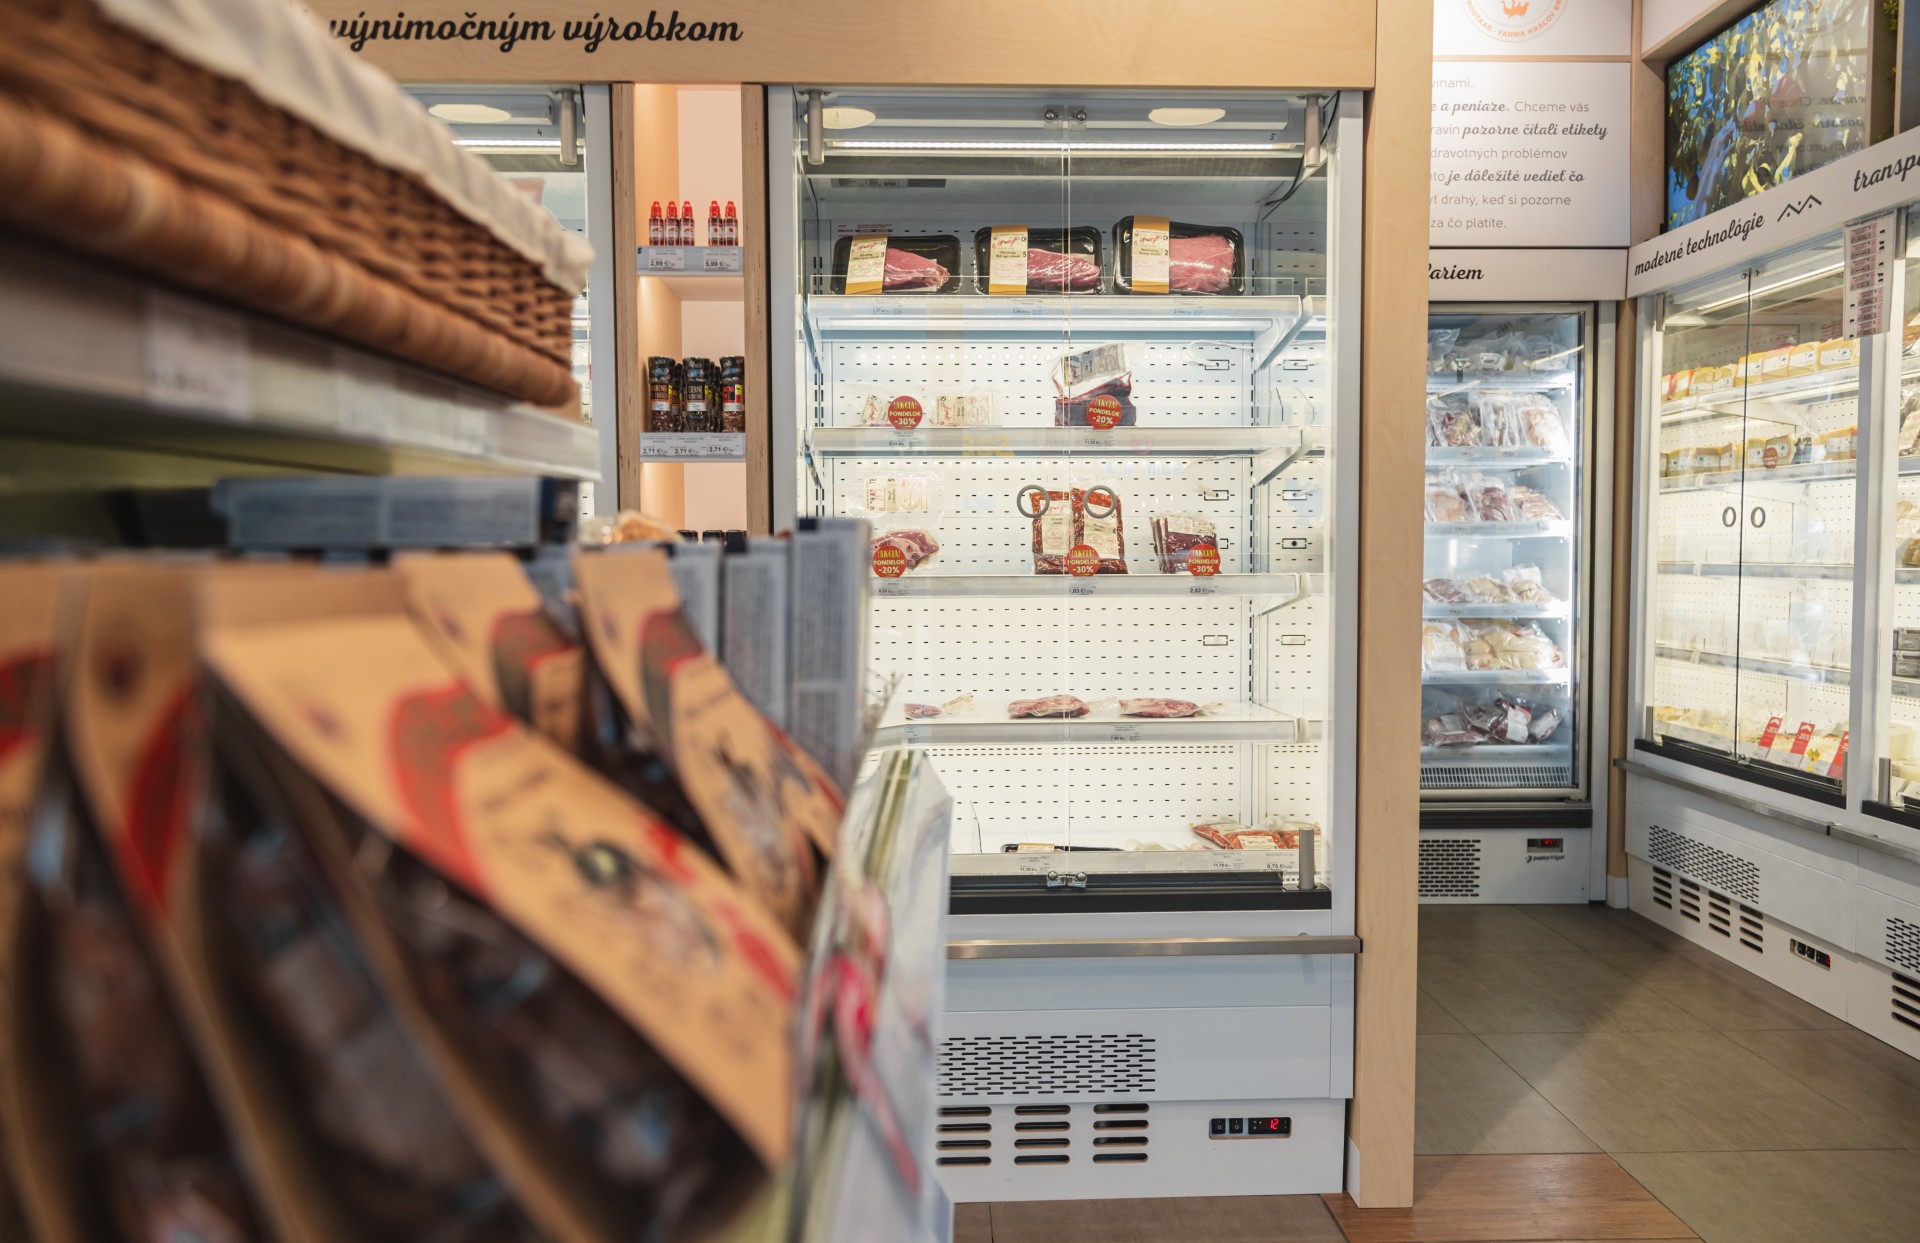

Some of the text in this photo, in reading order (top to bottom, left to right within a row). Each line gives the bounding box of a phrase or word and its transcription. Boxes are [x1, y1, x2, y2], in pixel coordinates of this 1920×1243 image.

[329, 11, 743, 53] výnimočným výrobkom
[1440, 103, 1450, 111] a
[1451, 99, 1510, 116] peniaze.
[1514, 101, 1567, 112] Chceme
[1570, 101, 1589, 112] vás
[1461, 124, 1520, 139] pozorne
[1523, 123, 1558, 135] čítali
[1561, 123, 1609, 140] etikety
[1502, 147, 1568, 160] problémov
[1444, 170, 1460, 186] je
[1464, 169, 1520, 182] dôležité
[1523, 169, 1567, 182] vedieť
[1568, 171, 1585, 182] čo
[1441, 194, 1478, 207] drahý,
[1482, 194, 1507, 206] keď
[1508, 195, 1517, 206] si
[1520, 195, 1572, 207] pozorne
[1431, 219, 1444, 228] za
[1447, 217, 1463, 228] čo
[1634, 212, 1765, 276] moderné technológie
[1089, 407, 1120, 417] PONDELOK
[1092, 415, 1113, 424] -20%
[878, 566, 899, 574] -20%
[1072, 565, 1093, 573] -30%
[1193, 565, 1214, 573] -30%
